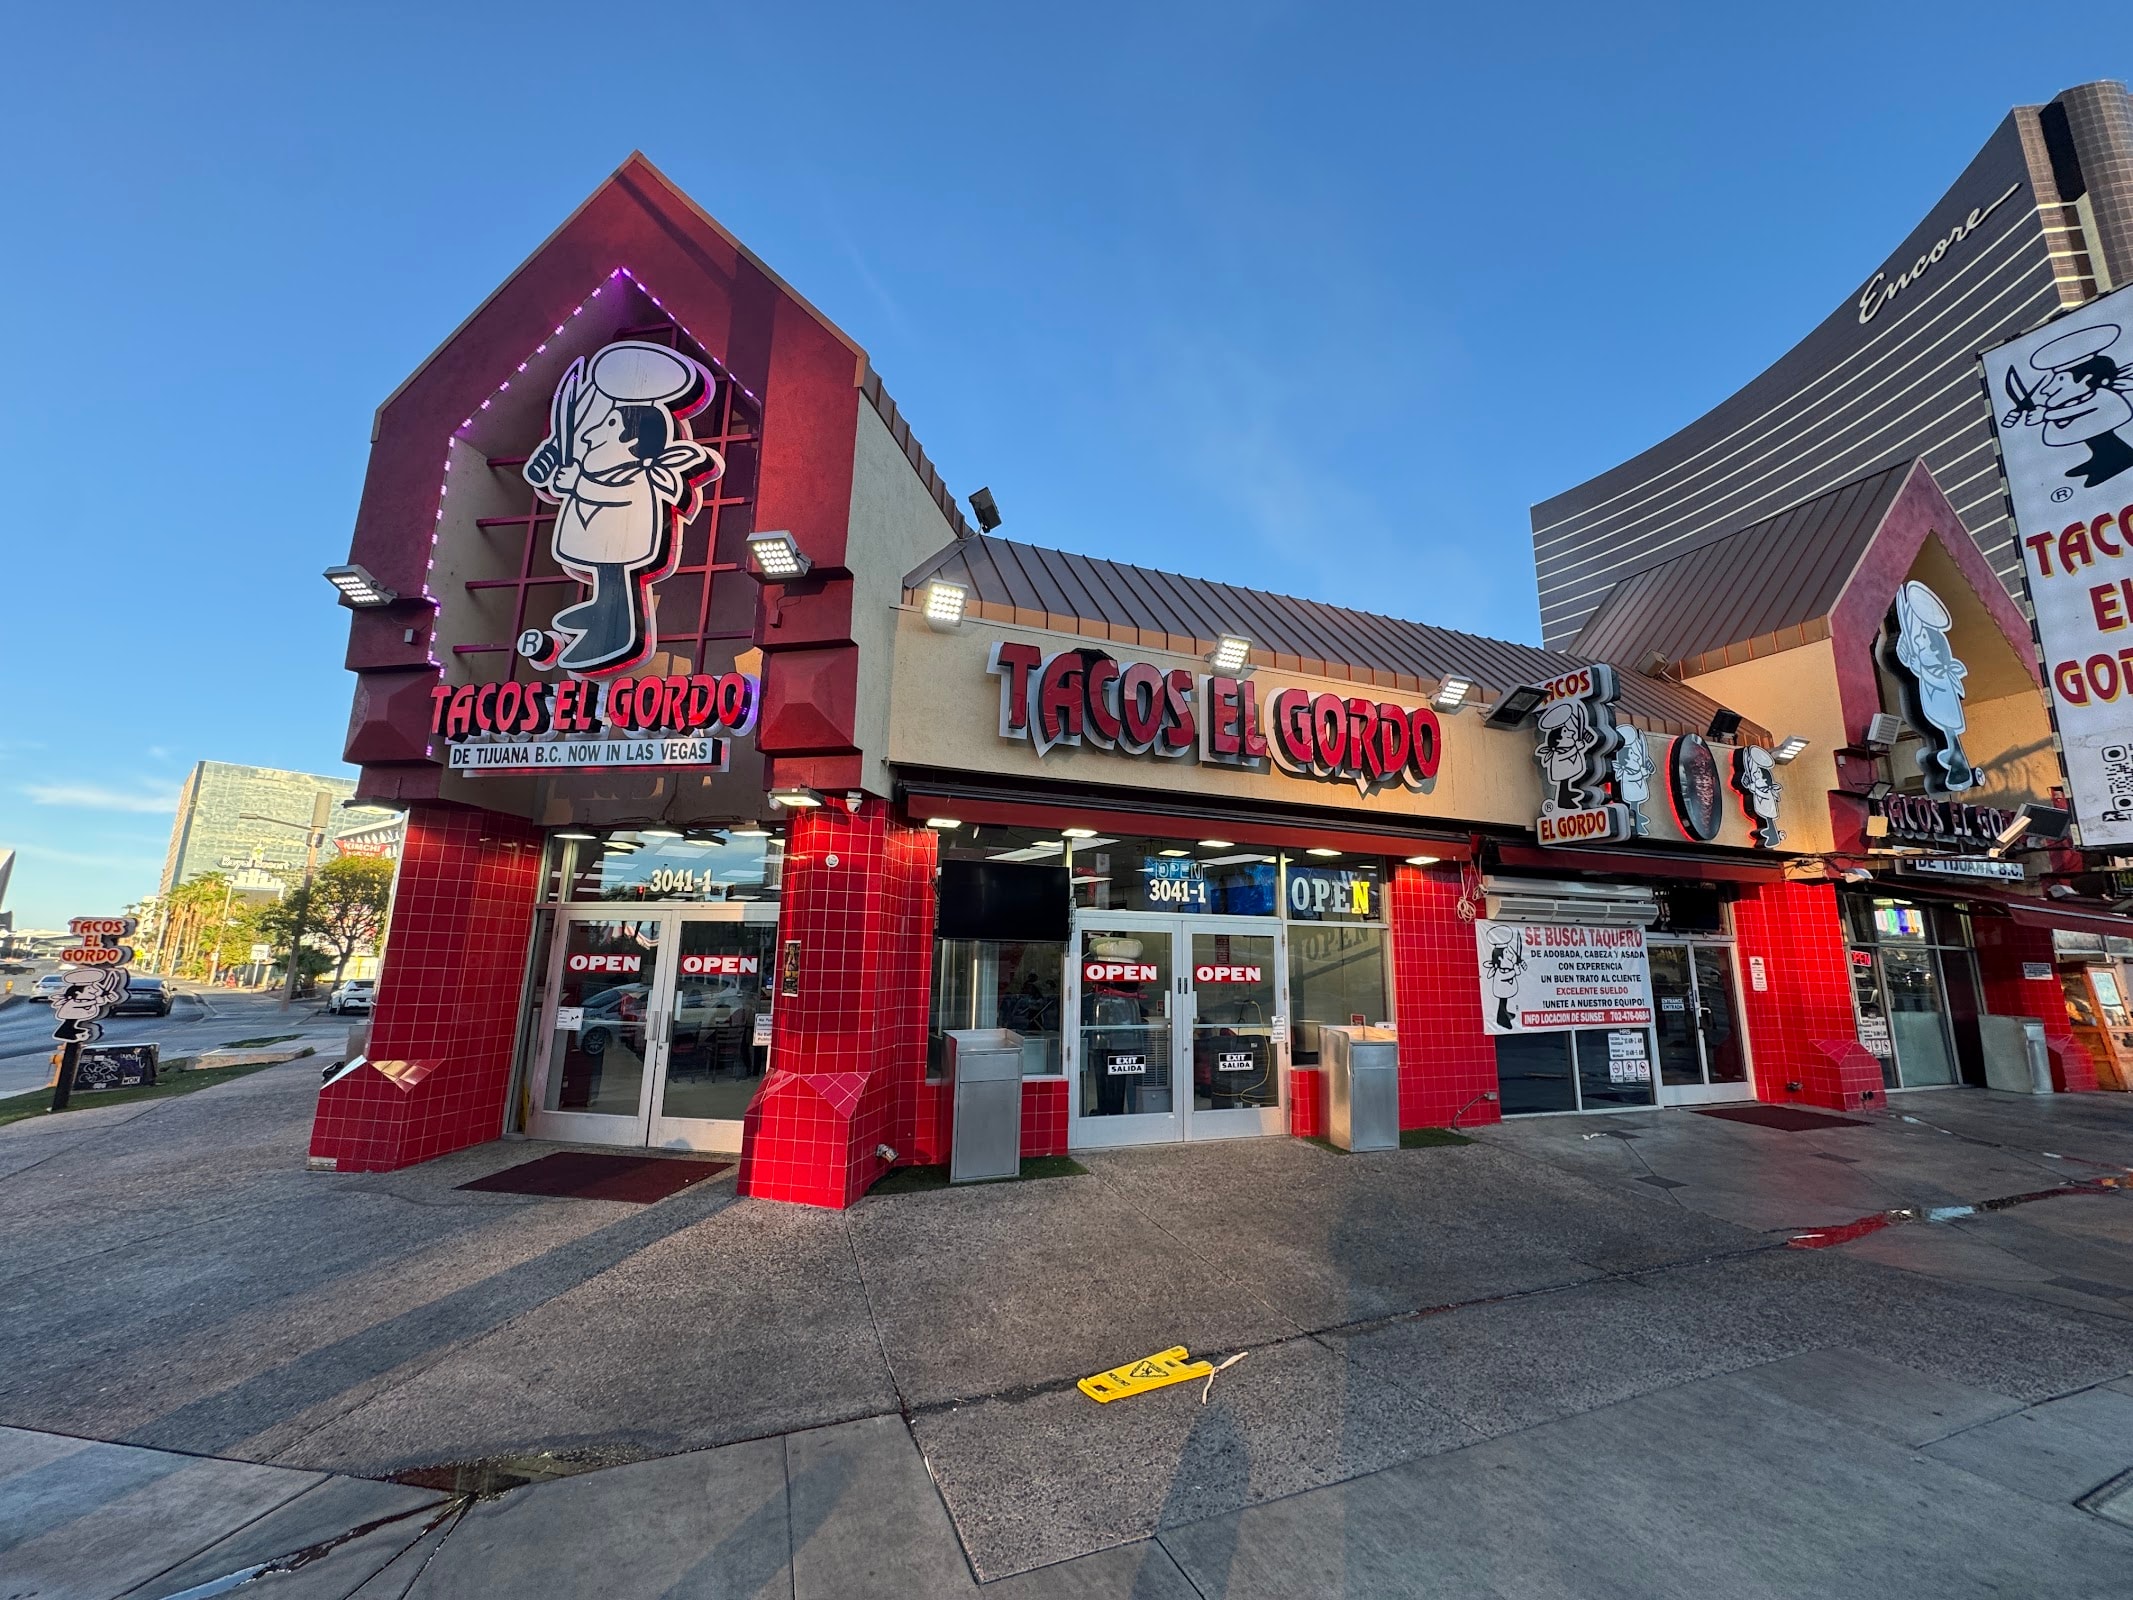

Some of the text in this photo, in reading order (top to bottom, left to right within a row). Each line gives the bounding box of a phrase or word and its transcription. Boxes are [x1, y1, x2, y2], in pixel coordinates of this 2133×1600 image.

[1859, 182, 2021, 324] Encore
[430, 672, 748, 738] TACOS EL GORDO
[999, 642, 1442, 779] TACOS EL GORDO
[452, 742, 708, 765] DE TIJUANA B.C. NOW IN LAS VEGAS
[1541, 811, 1606, 840] EL GORDO
[343, 842, 381, 852] KIMCHI
[650, 868, 713, 893] 3041-1
[1149, 879, 1207, 903] 3041-1
[1291, 877, 1371, 914] OPEN
[71, 920, 124, 934] TACOS
[84, 935, 102, 947] EL
[1525, 926, 1643, 949] SE BUSCA TAQUERO
[61, 949, 119, 963] GORDO
[1531, 950, 1541, 958] DE
[1543, 950, 1582, 959] ADOBADA,
[1584, 950, 1613, 958] CABEZA
[1620, 951, 1645, 959] ASADA
[569, 955, 641, 972] OPEN
[683, 956, 758, 973] OPEN
[1558, 962, 1623, 970] CON EXPERENCIA
[1086, 965, 1157, 981] OPEN
[1196, 966, 1261, 982] OPEN
[1540, 975, 1552, 983] UN
[1554, 975, 1574, 983] BUEN
[1575, 975, 1599, 983] TRATO
[1611, 974, 1641, 982] CLIENTE
[1556, 986, 1628, 995] EXCELENTE SUELDO
[1577, 999, 1613, 1008] NUESTRO
[1614, 998, 1645, 1007] EQUIPO!
[1524, 1014, 1540, 1024] INFO
[1541, 1013, 1571, 1024] LOCACION
[1571, 1012, 1580, 1022] DE
[1581, 1012, 1605, 1022] SUNSET
[1115, 1056, 1138, 1065] EXIT
[1225, 1054, 1246, 1062] EXIT
